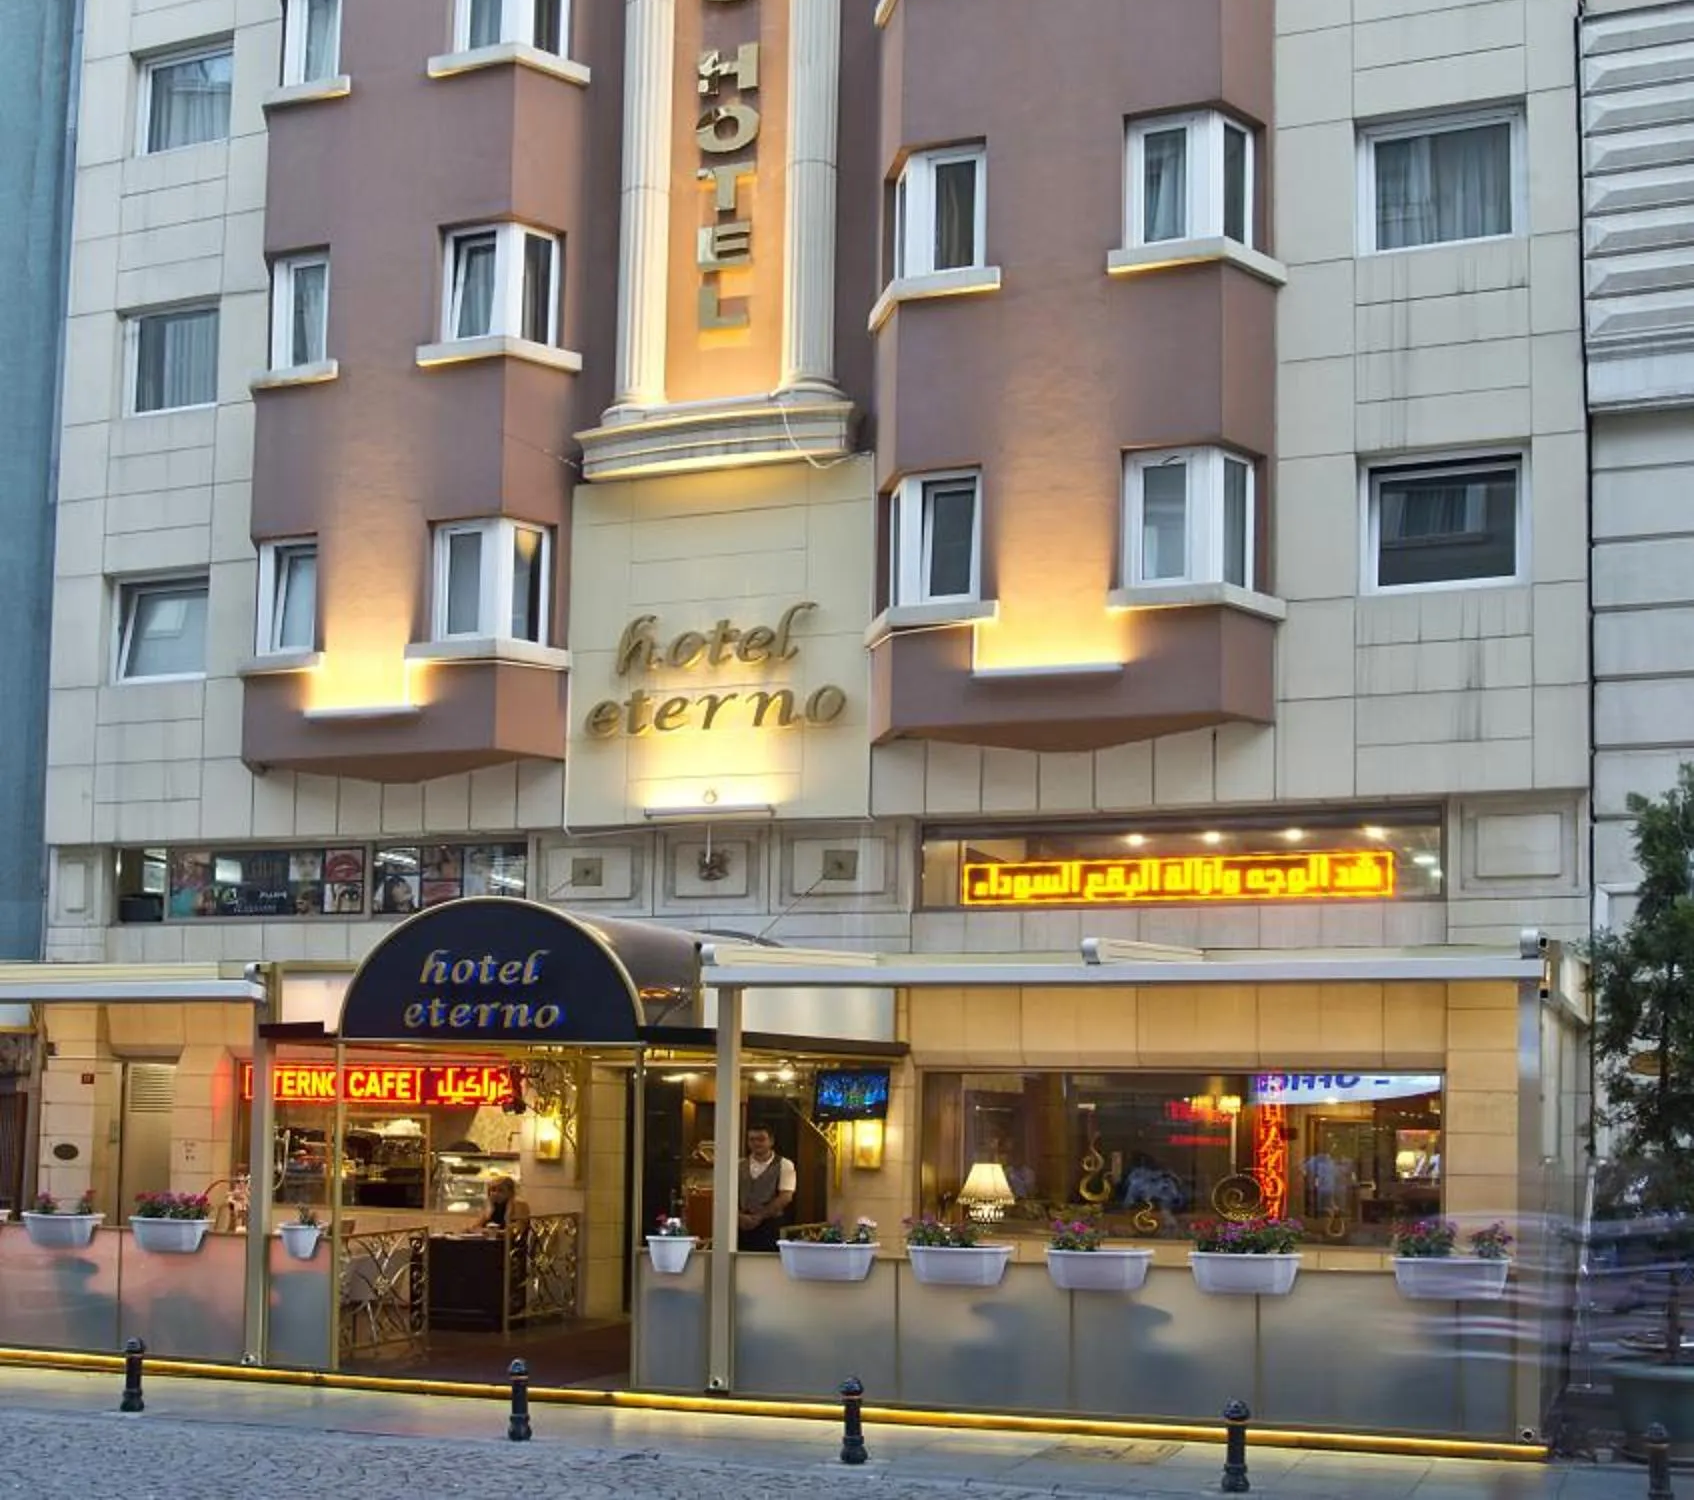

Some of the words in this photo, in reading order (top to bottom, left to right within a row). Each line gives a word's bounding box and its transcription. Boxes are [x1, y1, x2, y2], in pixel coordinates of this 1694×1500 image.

[695, 42, 760, 330] HOTEL
[616, 601, 818, 676] hotel
[585, 684, 848, 738] eterno
[418, 949, 551, 985] hotel
[403, 997, 561, 1029] eterno
[268, 1070, 340, 1098] TERNO
[349, 1071, 412, 1098] CAFE
